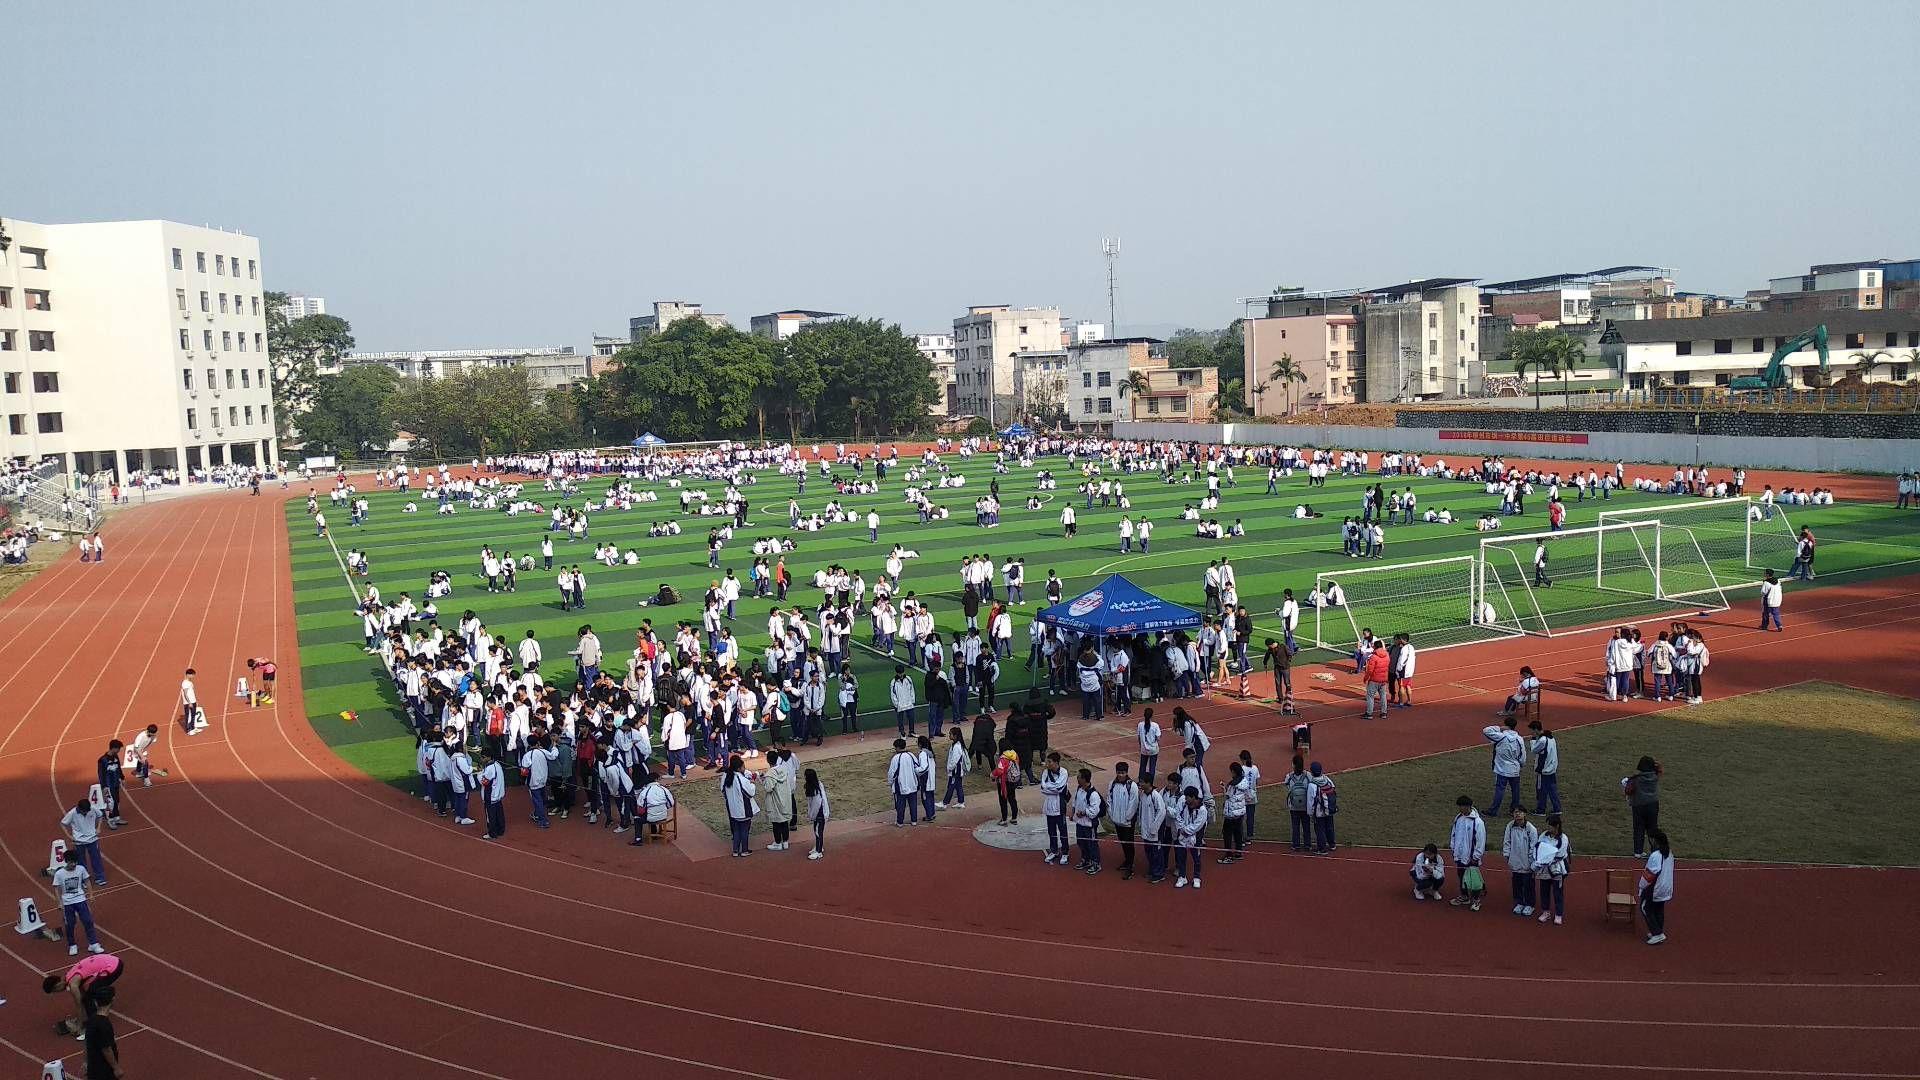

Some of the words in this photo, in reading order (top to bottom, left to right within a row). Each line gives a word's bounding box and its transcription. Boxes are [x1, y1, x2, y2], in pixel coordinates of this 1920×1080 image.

[195, 711, 203, 722] 2
[127, 750, 134, 762] 3
[91, 789, 98, 804] 4
[55, 845, 64, 862] 5
[27, 904, 36, 923] 6
